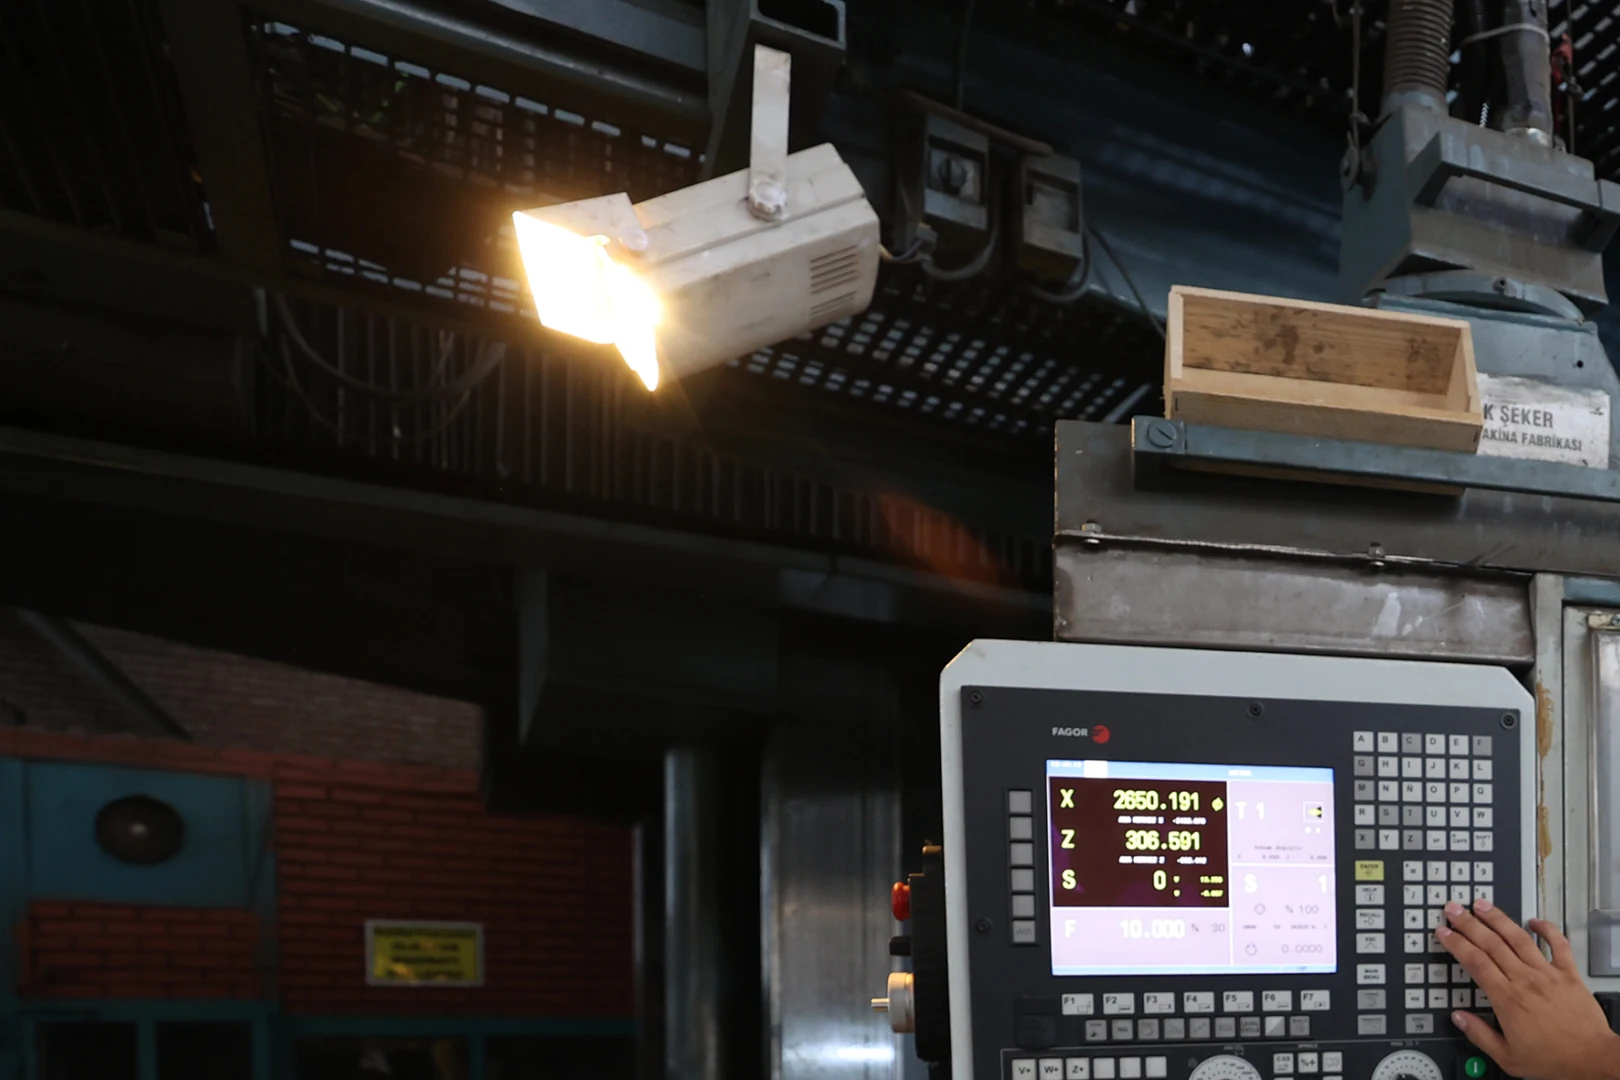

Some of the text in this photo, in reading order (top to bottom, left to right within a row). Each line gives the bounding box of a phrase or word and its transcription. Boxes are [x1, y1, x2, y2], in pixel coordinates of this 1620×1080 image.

[1484, 404, 1553, 428] K ŞEKER
[1482, 428, 1517, 444] AKİNA
[1052, 727, 1088, 737] FAGOR
[1358, 734, 1365, 742] A
[1382, 735, 1389, 744] B
[1406, 736, 1412, 745] C
[1429, 737, 1437, 746] D
[1453, 738, 1459, 746] E
[1358, 759, 1366, 768] G
[1382, 760, 1389, 768] H
[1430, 762, 1436, 770] J
[1477, 763, 1483, 771] L
[1382, 784, 1390, 792] N
[1406, 784, 1413, 792] Ñ
[1430, 785, 1438, 794] O
[1454, 786, 1460, 794] P
[1476, 787, 1484, 795] Q
[1060, 789, 1200, 811] X 2650.191
[1235, 801, 1265, 820] T 1
[1383, 808, 1390, 816] S
[1430, 810, 1438, 818] U
[1454, 810, 1460, 818] V
[1061, 829, 1200, 850] Z 306.591
[1384, 834, 1390, 842] Y
[1407, 834, 1413, 843] Z
[1434, 867, 1440, 875] 7
[1458, 868, 1463, 876] 8
[1481, 868, 1487, 876] 9
[1062, 869, 1077, 890] S
[1153, 870, 1167, 890] 0
[1244, 874, 1257, 893] S
[1317, 875, 1327, 893] 1
[1481, 892, 1487, 900] 6
[1299, 904, 1319, 914] 100
[1064, 919, 1077, 938] F
[1118, 918, 1185, 938] 10.000
[1211, 923, 1226, 933] 30
[1282, 944, 1323, 953] 0.0000
[1064, 996, 1075, 1005] F1
[1105, 996, 1117, 1004] F2
[1146, 995, 1158, 1004] F3
[1225, 994, 1237, 1002] F5
[1264, 994, 1276, 1002] F6
[1072, 1065, 1084, 1074] Z+
